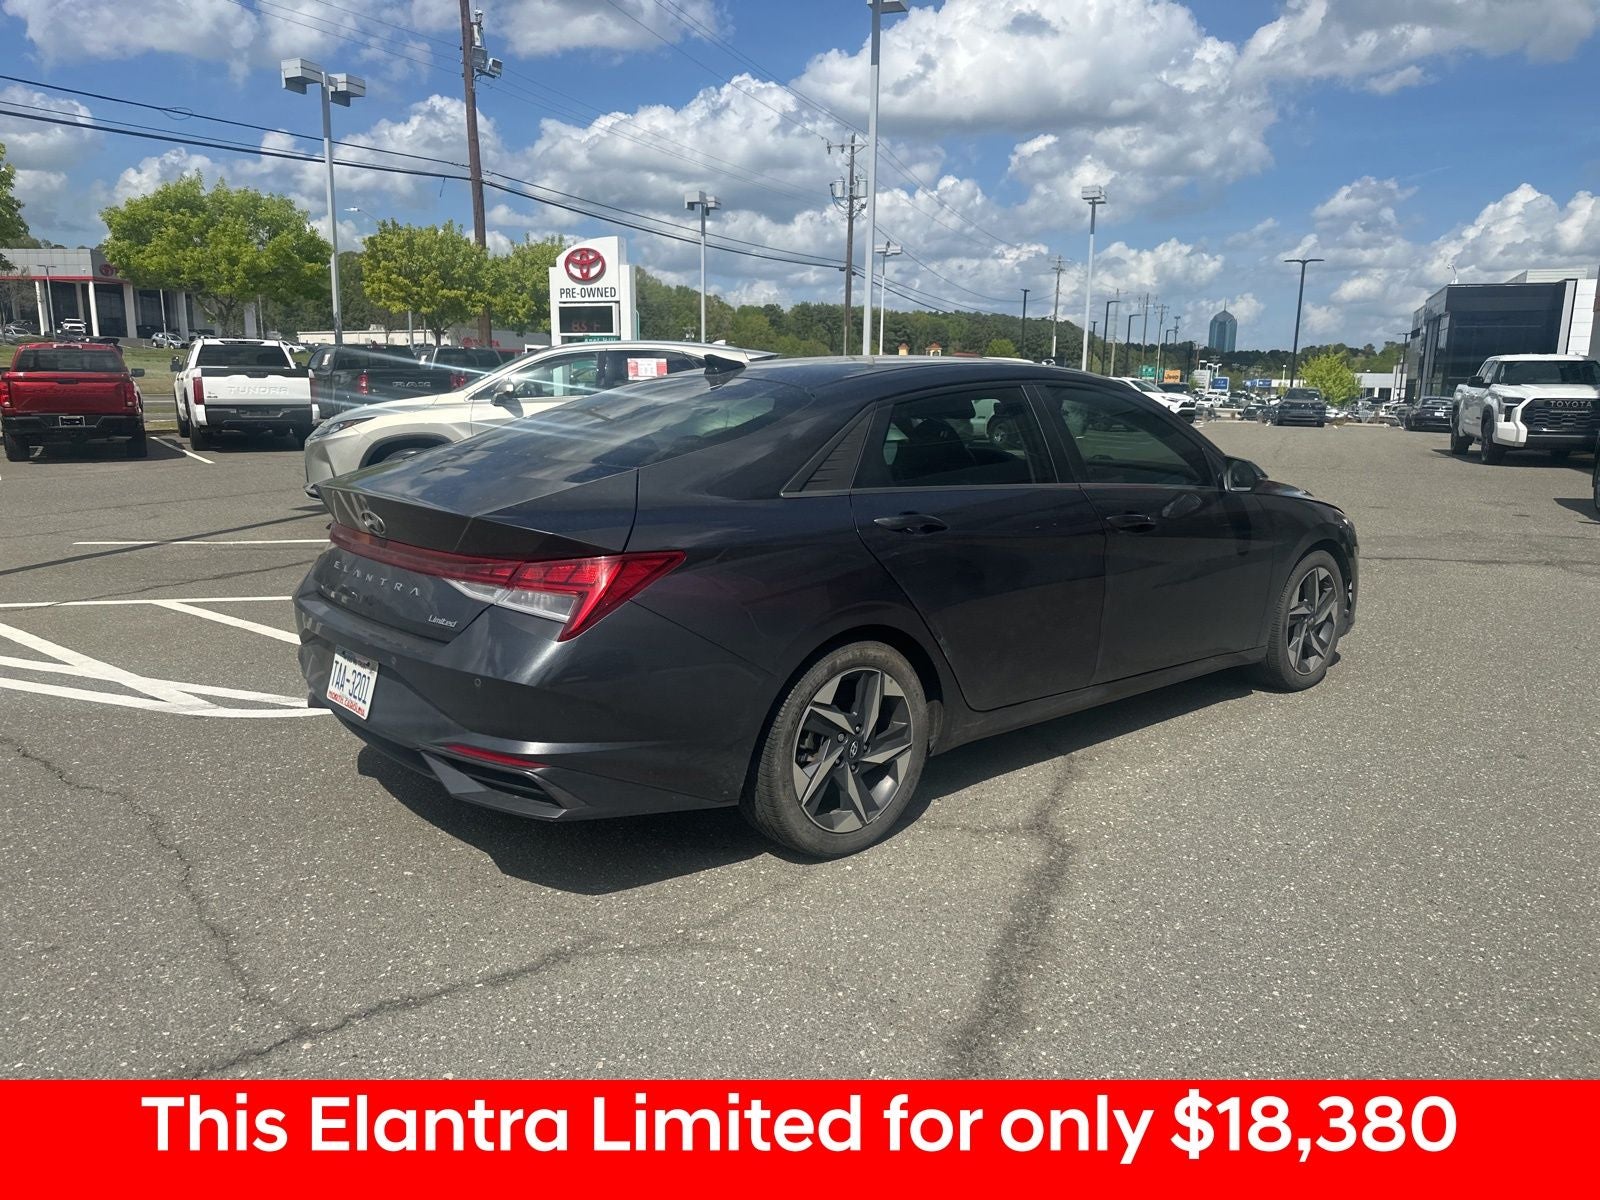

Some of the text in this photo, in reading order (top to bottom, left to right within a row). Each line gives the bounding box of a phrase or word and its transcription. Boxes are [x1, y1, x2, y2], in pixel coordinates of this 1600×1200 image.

[560, 287, 617, 299] PRE-OWNED
[227, 385, 289, 395] TUNDRA
[1550, 400, 1592, 408] TOYOTA
[333, 560, 421, 597] ELANTRA
[428, 614, 458, 628] Limited
[331, 660, 371, 705] TAA-3201
